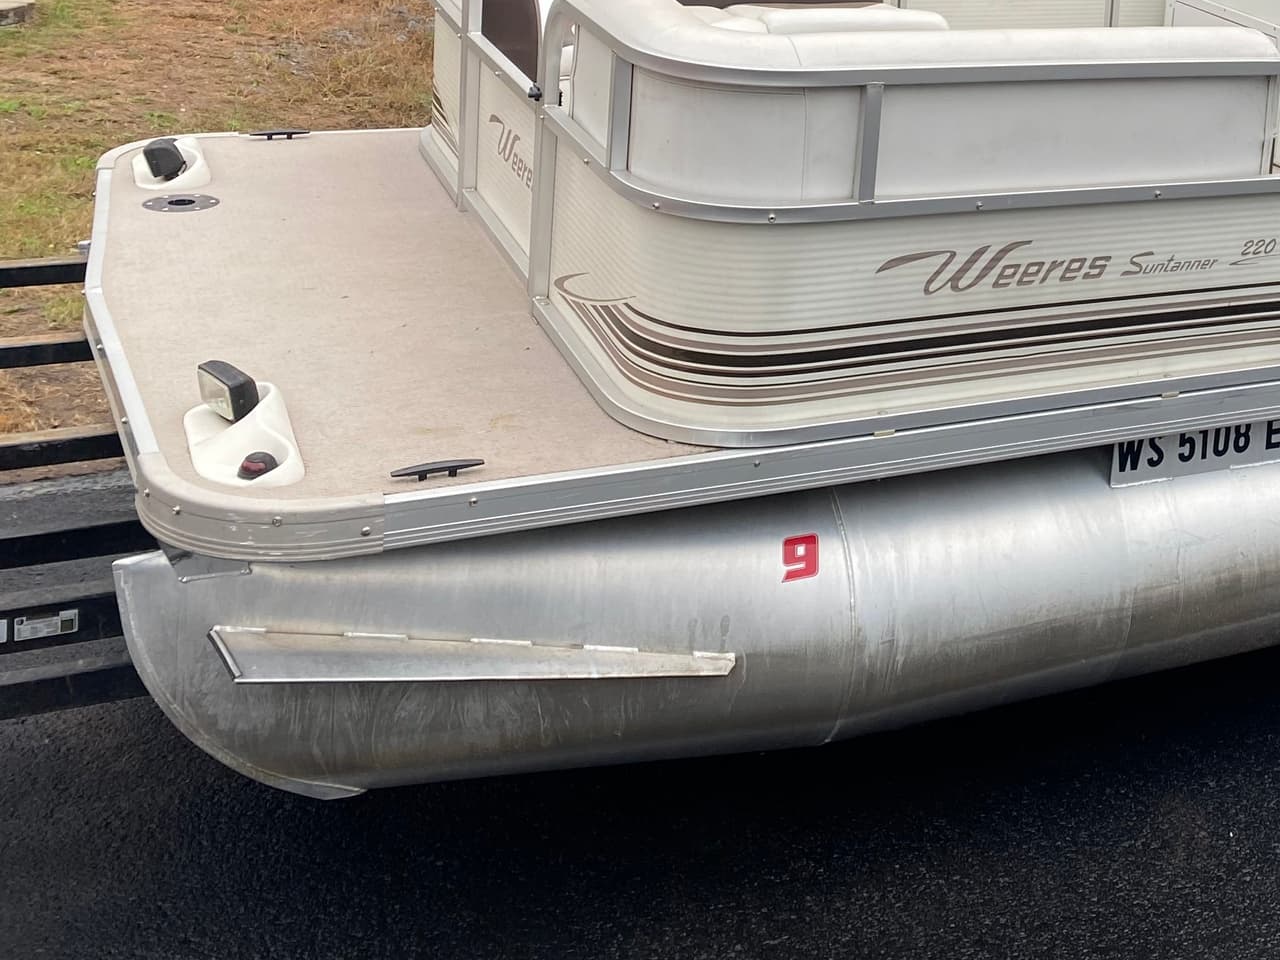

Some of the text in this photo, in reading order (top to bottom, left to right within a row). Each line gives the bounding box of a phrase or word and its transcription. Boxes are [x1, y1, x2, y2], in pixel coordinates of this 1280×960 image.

[876, 238, 1277, 296] Weeres Suntanner 220
[1118, 436, 1164, 472] WS
[1178, 423, 1252, 463] 5108
[782, 533, 819, 583] 9
